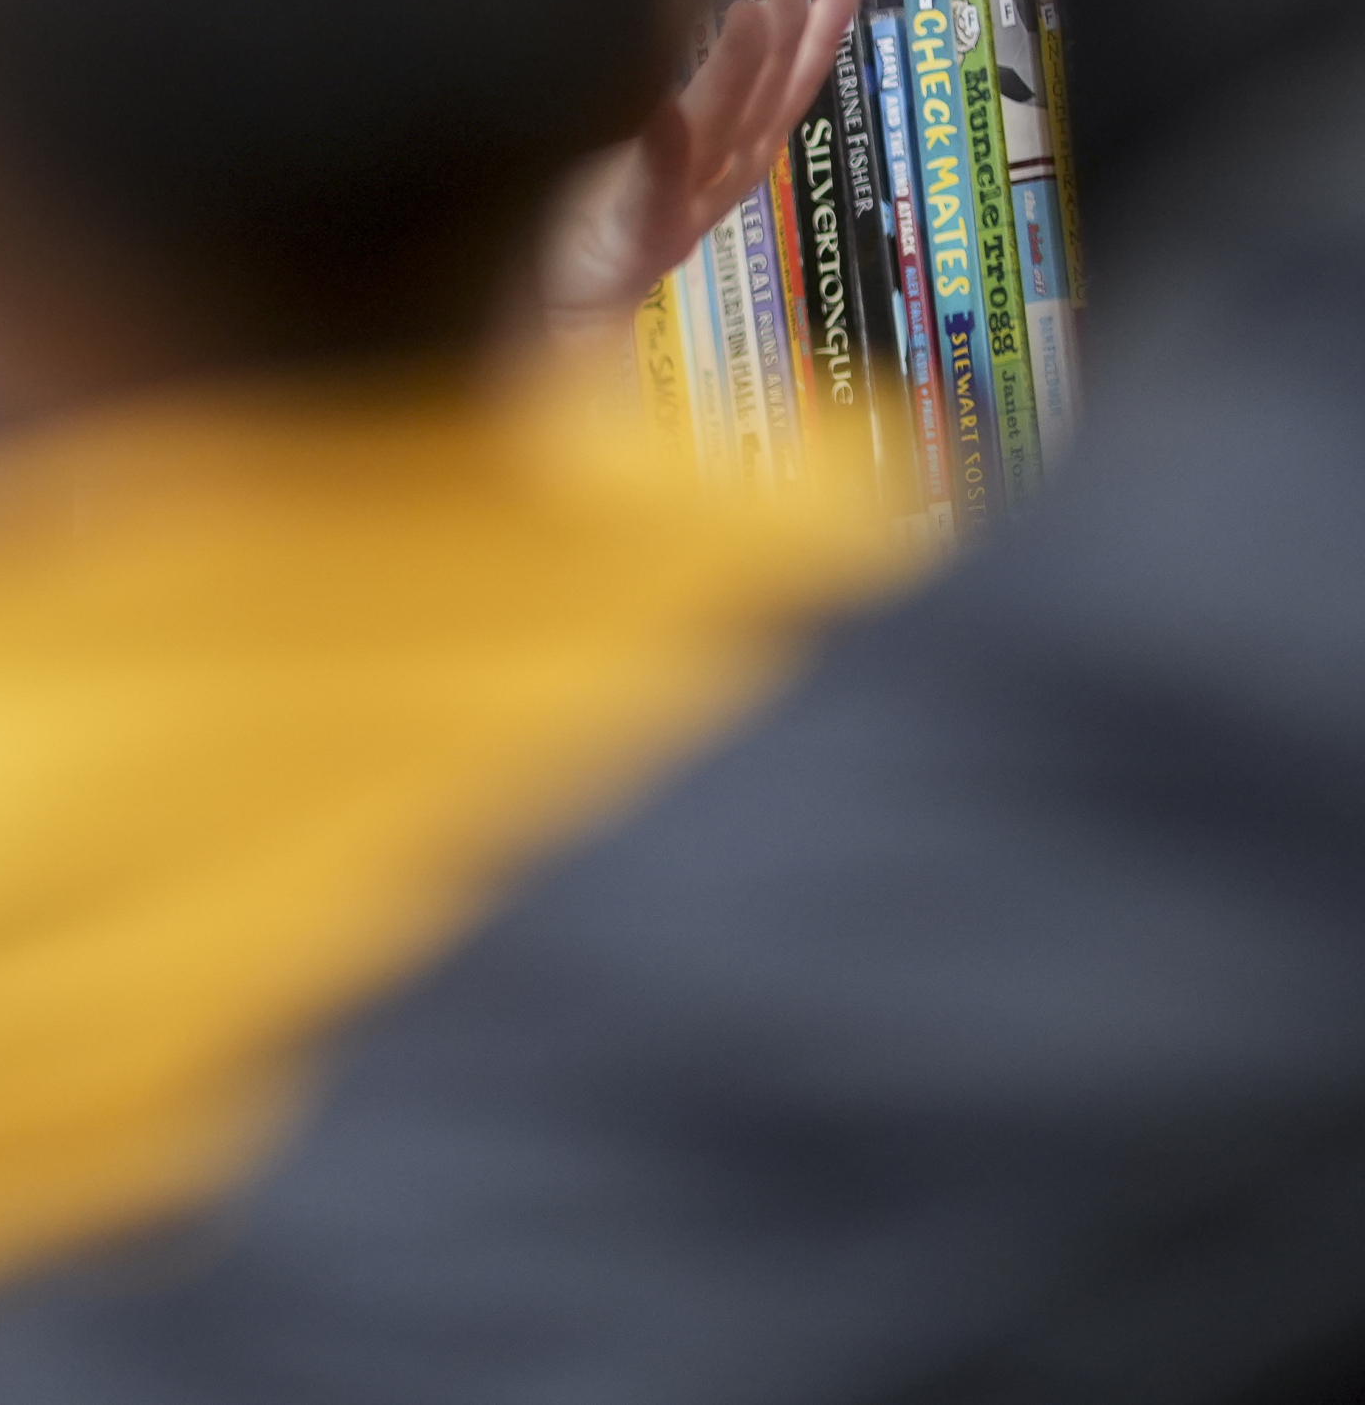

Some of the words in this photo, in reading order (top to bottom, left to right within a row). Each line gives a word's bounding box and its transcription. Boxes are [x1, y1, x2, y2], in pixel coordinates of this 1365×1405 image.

[875, 35, 901, 90] MARV
[911, 8, 959, 150] CHECK
[886, 95, 902, 127] AND
[890, 130, 905, 157] THE
[846, 133, 874, 219] FISHER
[963, 67, 1003, 228] Muncle
[899, 200, 917, 257] ATTACK
[925, 155, 971, 298] MATES
[748, 252, 772, 303] CAT
[982, 235, 1019, 357] Trogg
[756, 310, 780, 367] RUNS
[950, 331, 980, 442] STEWART
[1000, 370, 1022, 439] Janet
